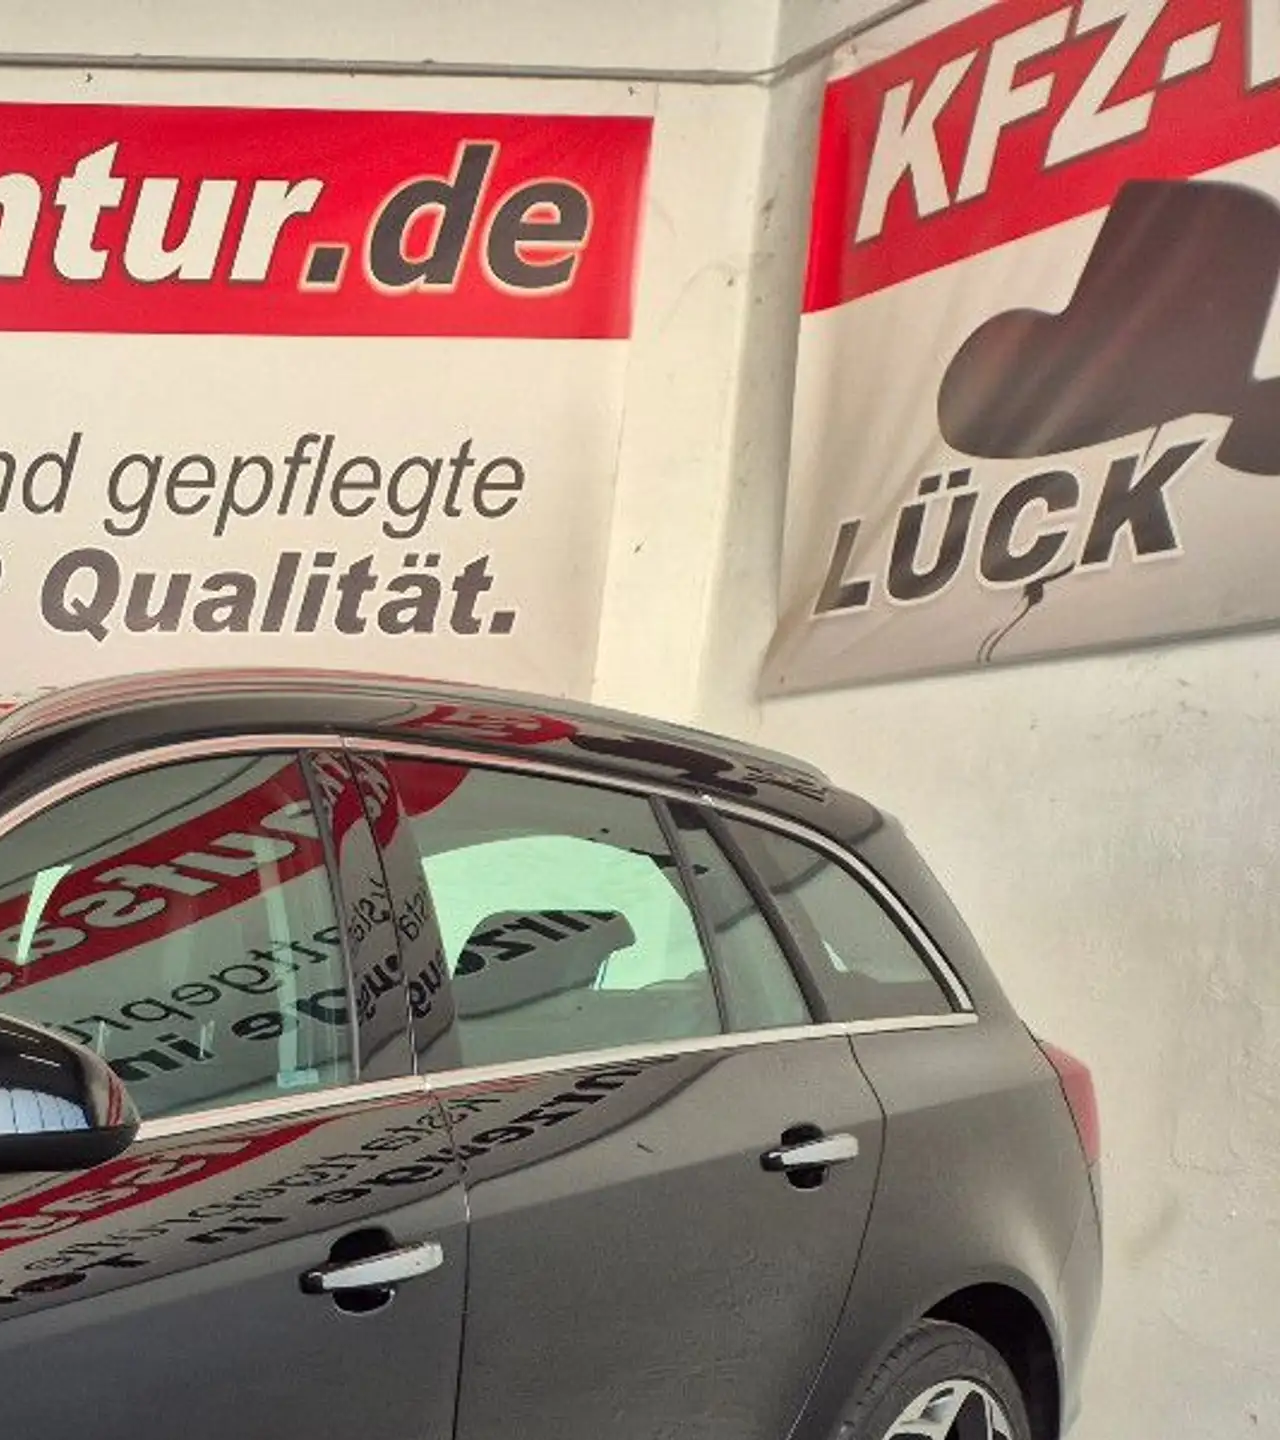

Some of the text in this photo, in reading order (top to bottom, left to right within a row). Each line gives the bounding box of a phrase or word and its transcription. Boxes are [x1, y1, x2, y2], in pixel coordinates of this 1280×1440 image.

[102, 433, 526, 539] gepflegte
[813, 437, 1208, 614] LÜCK
[41, 550, 516, 643] Qualität.
